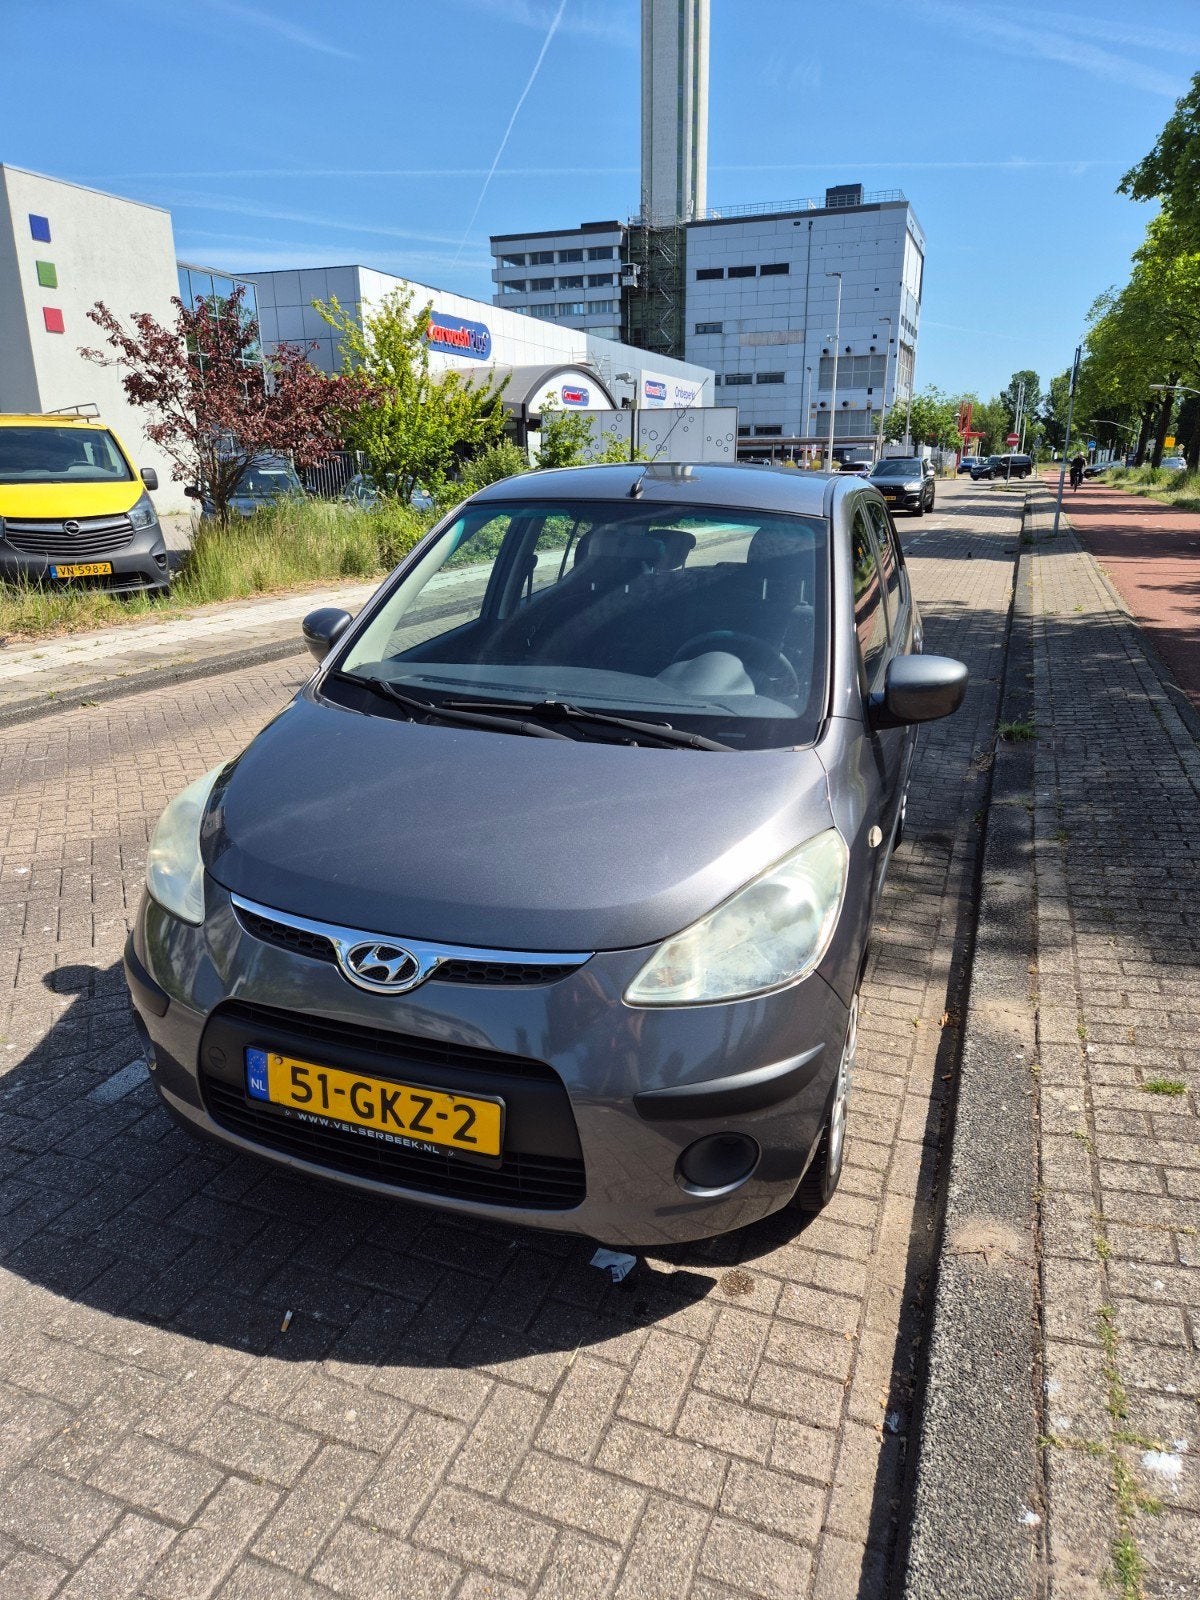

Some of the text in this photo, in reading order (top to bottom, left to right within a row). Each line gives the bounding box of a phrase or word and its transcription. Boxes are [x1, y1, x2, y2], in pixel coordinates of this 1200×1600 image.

[251, 1078, 267, 1092] NL
[290, 1065, 478, 1144] 51-GKZ-2
[297, 1111, 440, 1154] WWW.VELSERBEEK.NL
